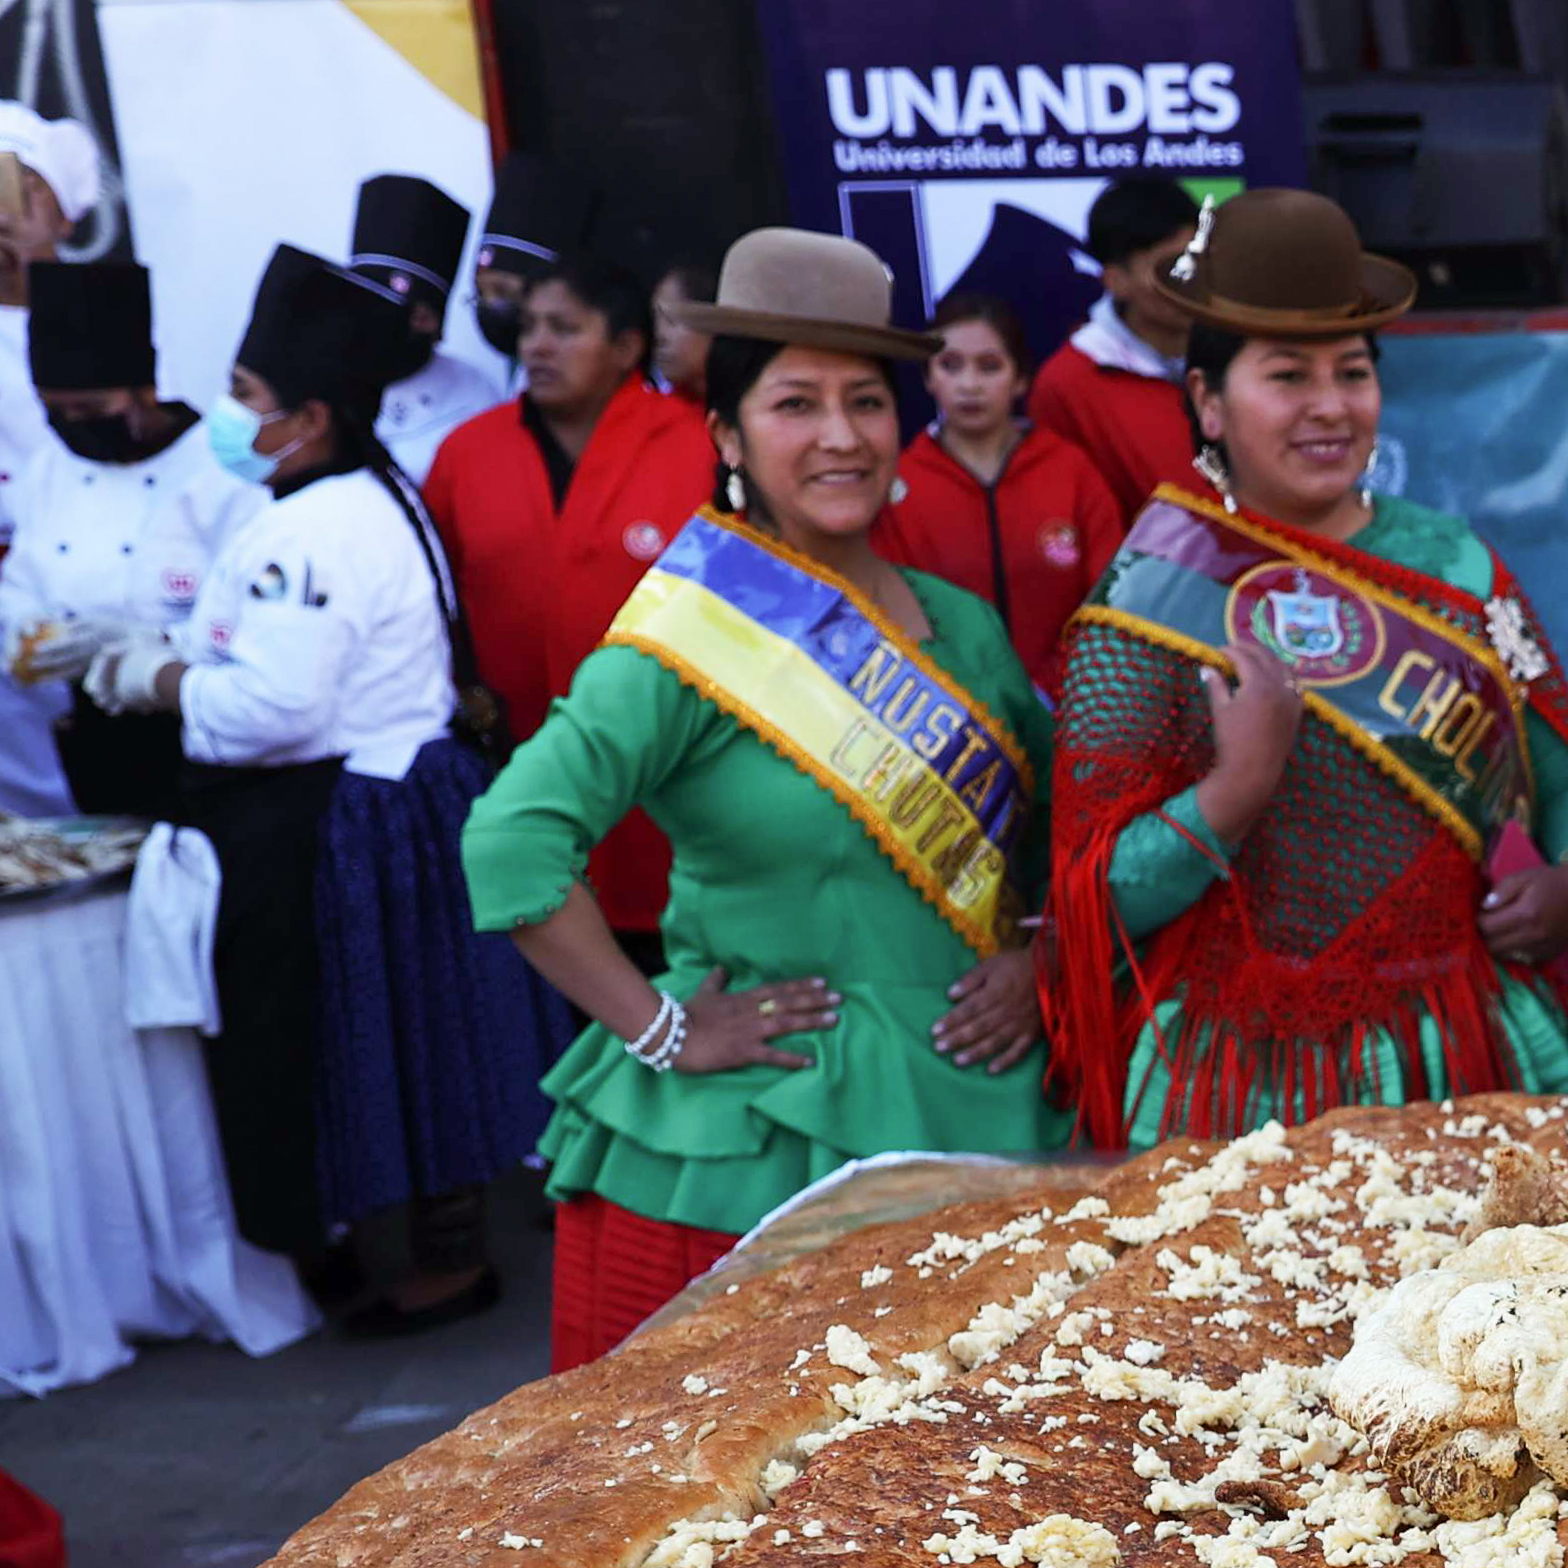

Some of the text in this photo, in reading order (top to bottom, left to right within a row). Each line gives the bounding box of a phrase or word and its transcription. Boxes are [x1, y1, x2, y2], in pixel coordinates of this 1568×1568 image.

[825, 62, 1241, 139] UNANDES
[833, 135, 1244, 172] Universidad de Los Andes
